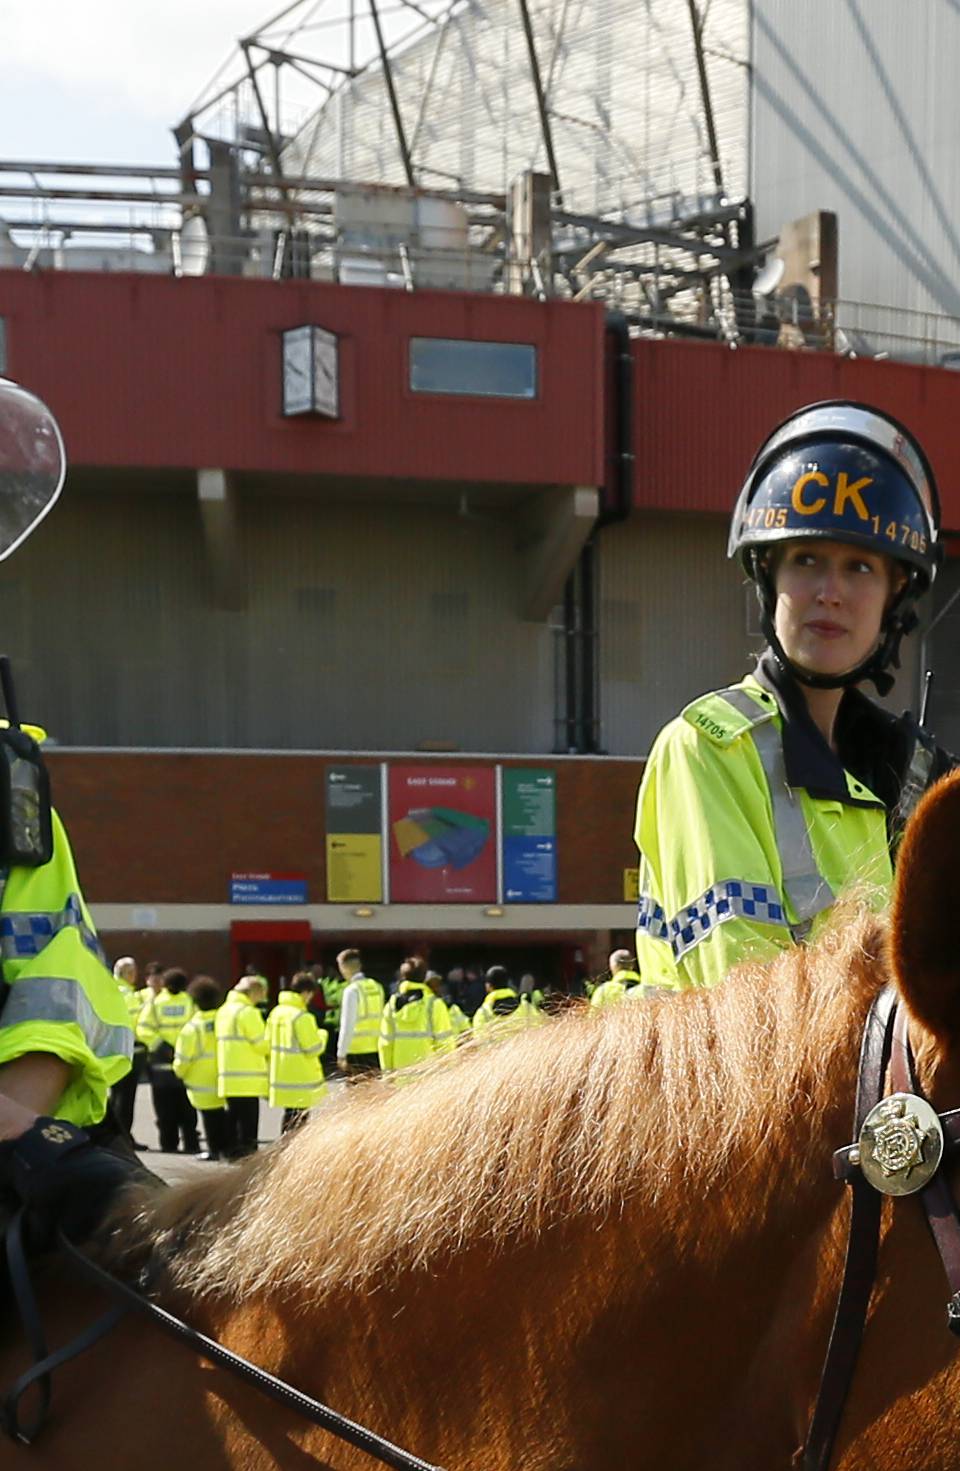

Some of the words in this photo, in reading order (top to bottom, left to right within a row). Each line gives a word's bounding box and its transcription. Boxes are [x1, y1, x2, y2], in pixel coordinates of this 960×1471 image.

[791, 469, 875, 521] CK
[871, 514, 928, 555] 14705
[695, 713, 727, 739] 14705
